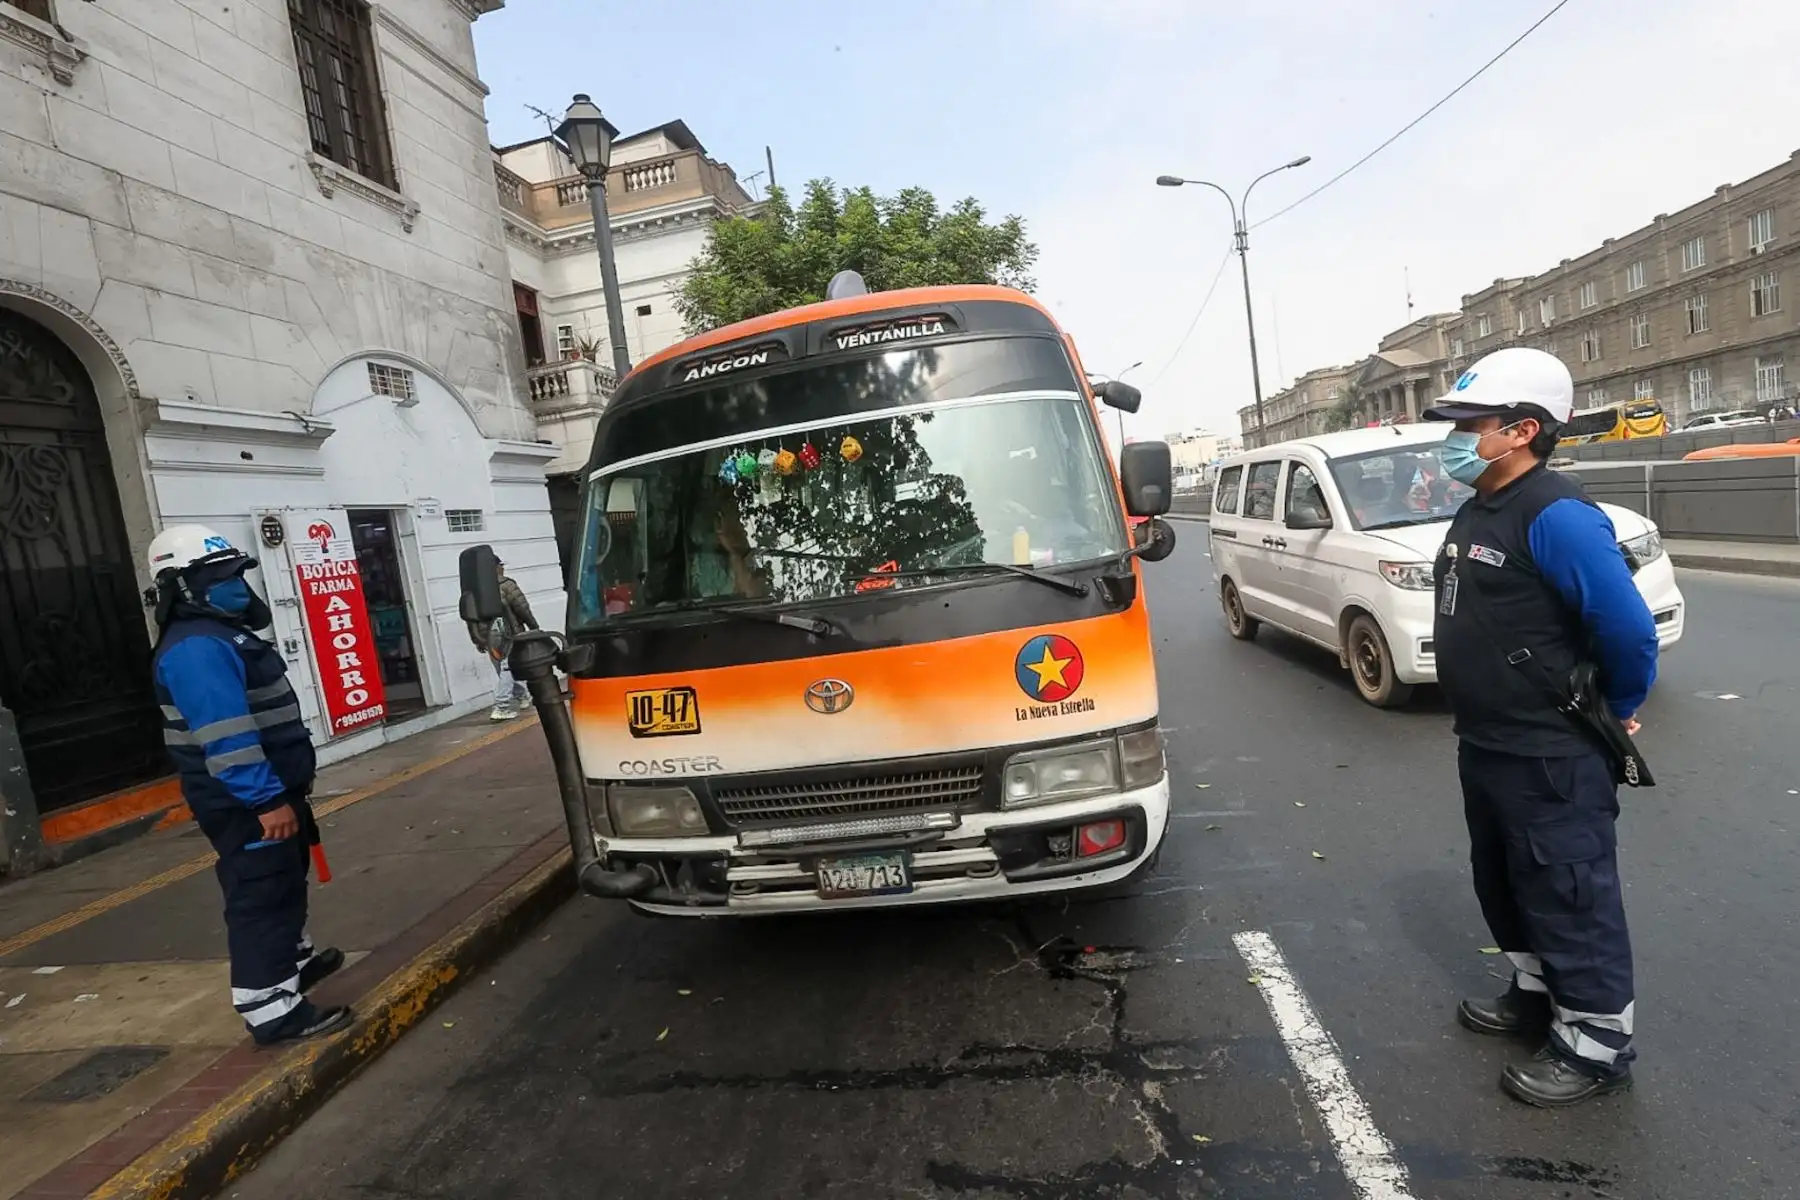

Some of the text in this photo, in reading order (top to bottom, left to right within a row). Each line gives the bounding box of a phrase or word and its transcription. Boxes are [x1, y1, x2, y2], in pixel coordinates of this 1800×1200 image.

[836, 322, 945, 349] VENTANILLA
[684, 352, 768, 382] ANCON
[300, 560, 357, 580] BOTICA
[310, 578, 355, 595] FARMA
[324, 595, 368, 706] AHORRO
[632, 692, 690, 725] 10-47
[1015, 698, 1095, 721] La Nueva Estrella
[619, 755, 724, 775] COASTER
